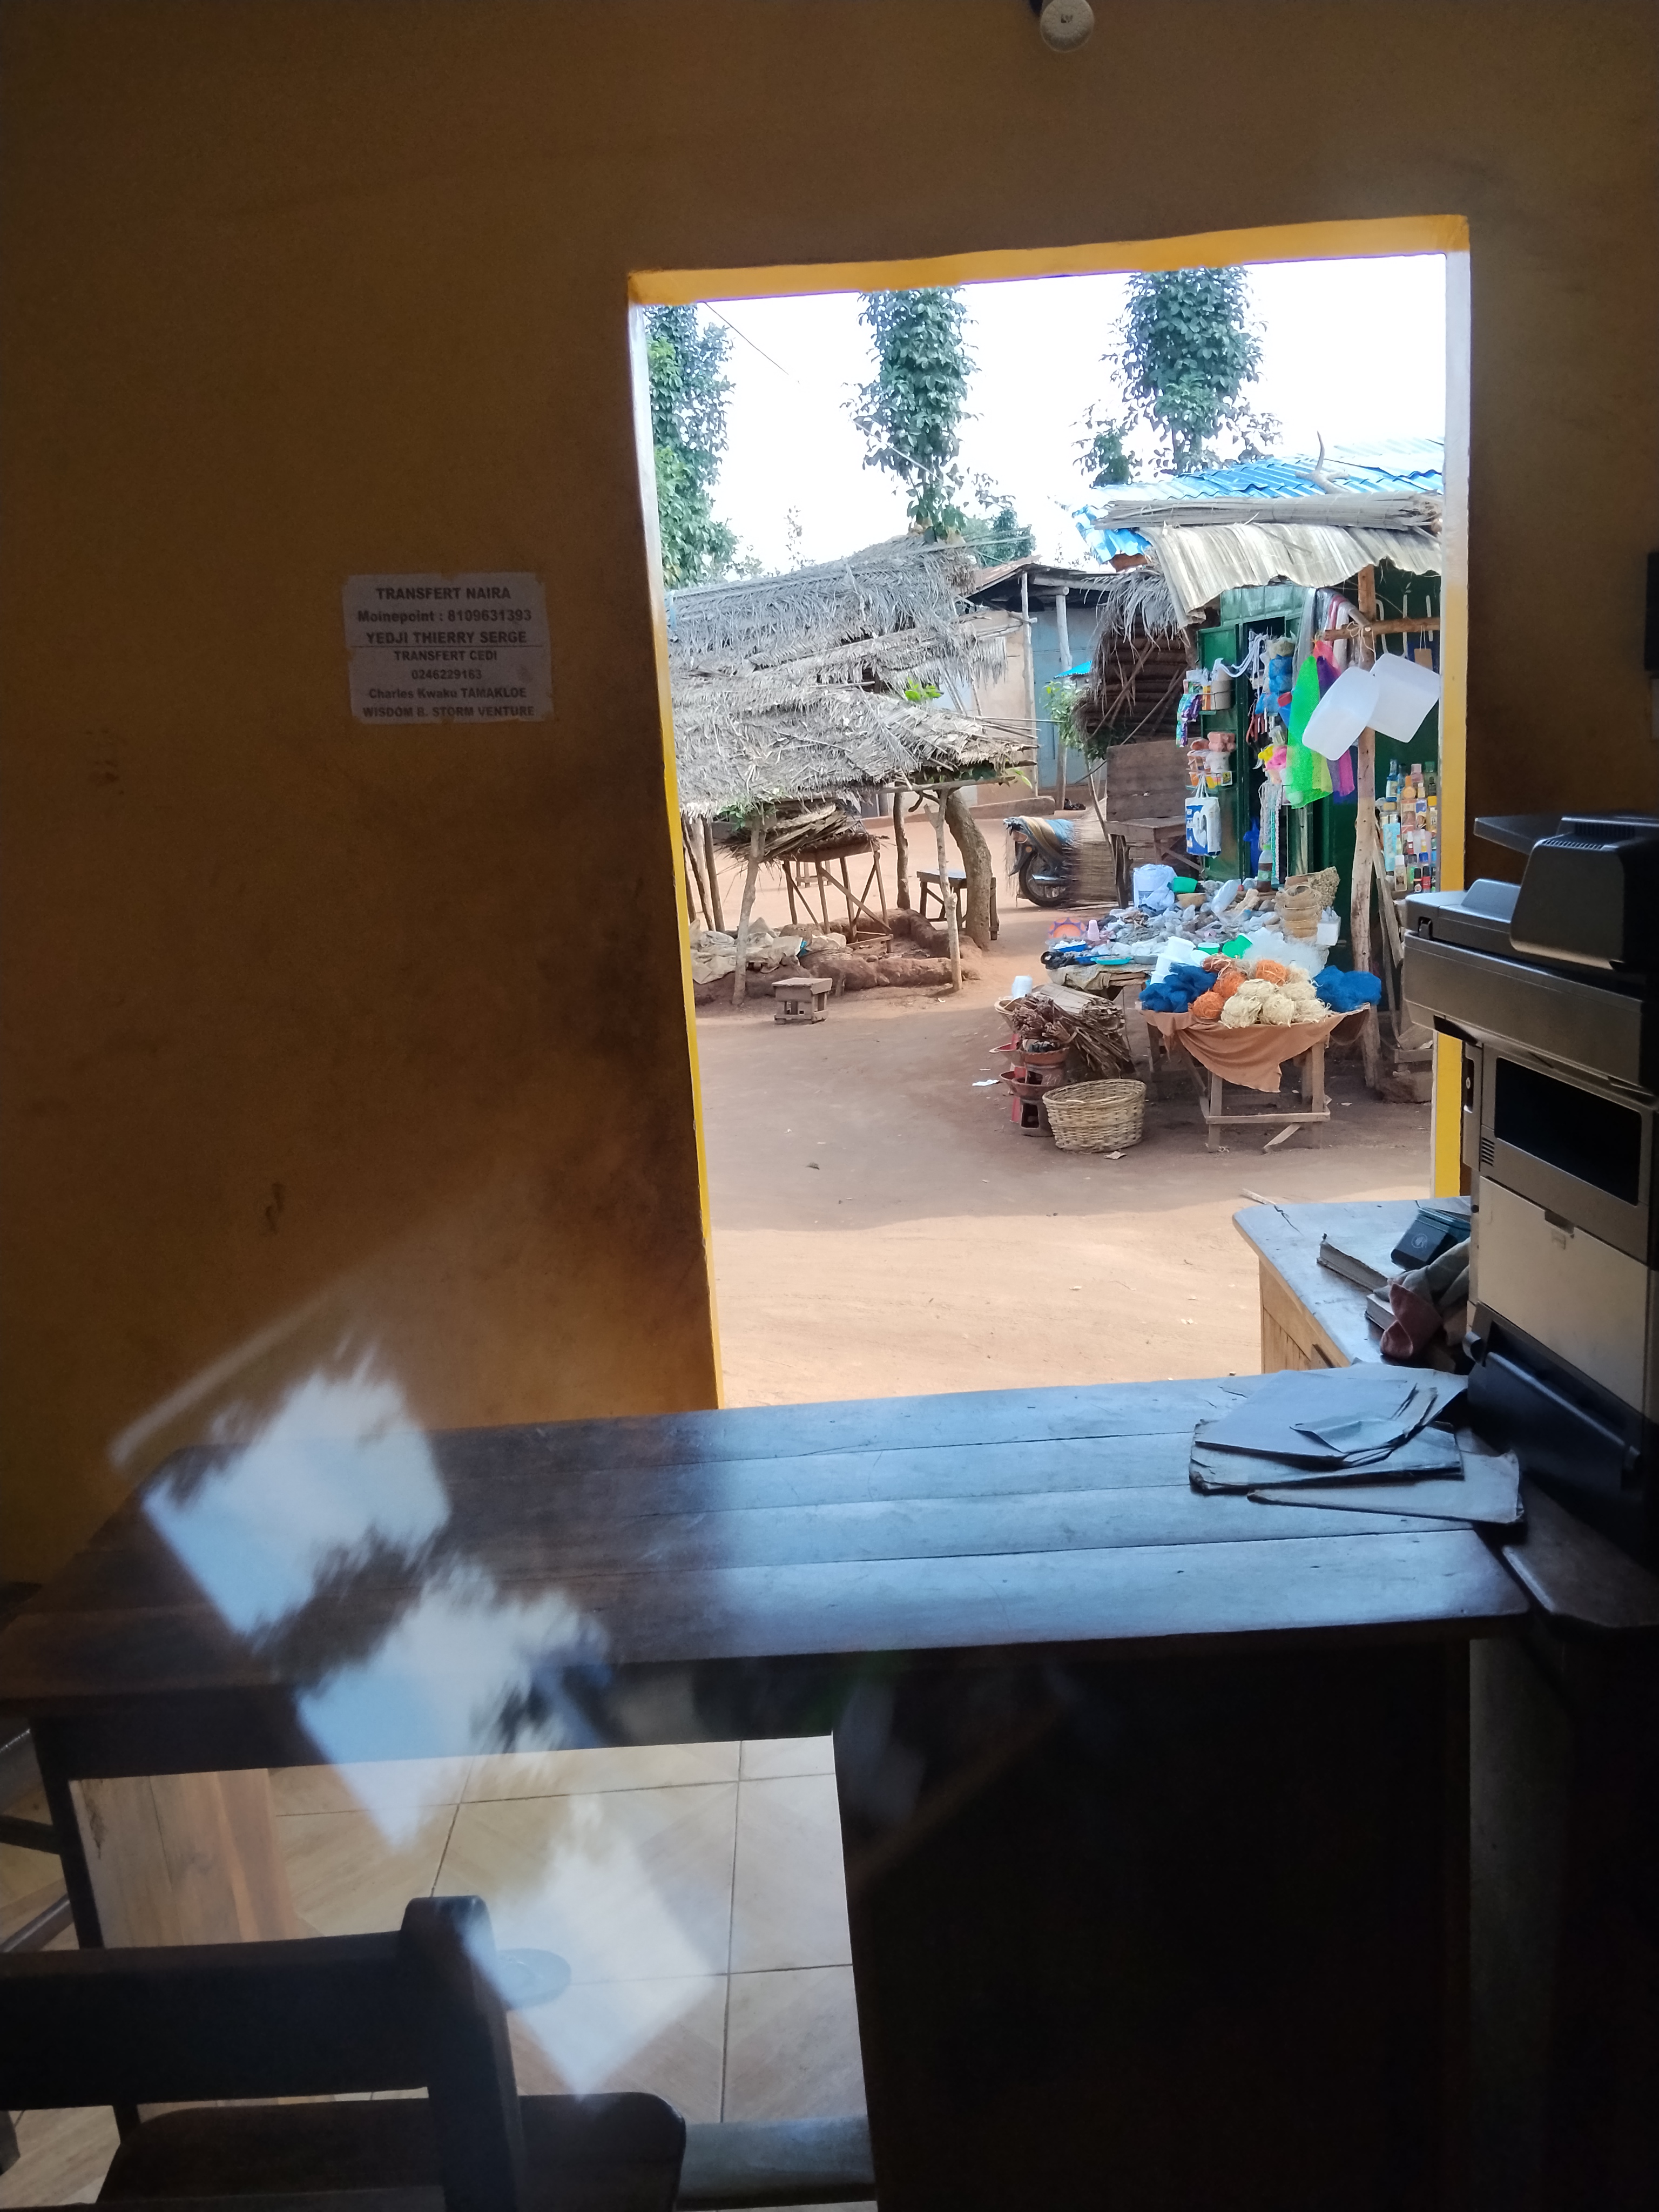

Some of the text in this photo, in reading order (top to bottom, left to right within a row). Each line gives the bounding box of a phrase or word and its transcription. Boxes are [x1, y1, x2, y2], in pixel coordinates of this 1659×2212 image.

[376, 587, 511, 599] TRANSFERT NAIRA
[358, 610, 434, 624] Moinepoint
[448, 609, 531, 621] 8109631393
[366, 631, 527, 644] YEDJI THIERRY SERGE
[394, 651, 497, 660] TRANSFERT CEDI
[412, 669, 482, 679] 0246229163
[369, 687, 527, 699] Charles Kwaku TAMAKLOE
[363, 707, 413, 717] WISDOM
[433, 706, 474, 717] STORM
[478, 706, 535, 717] VENTURE
